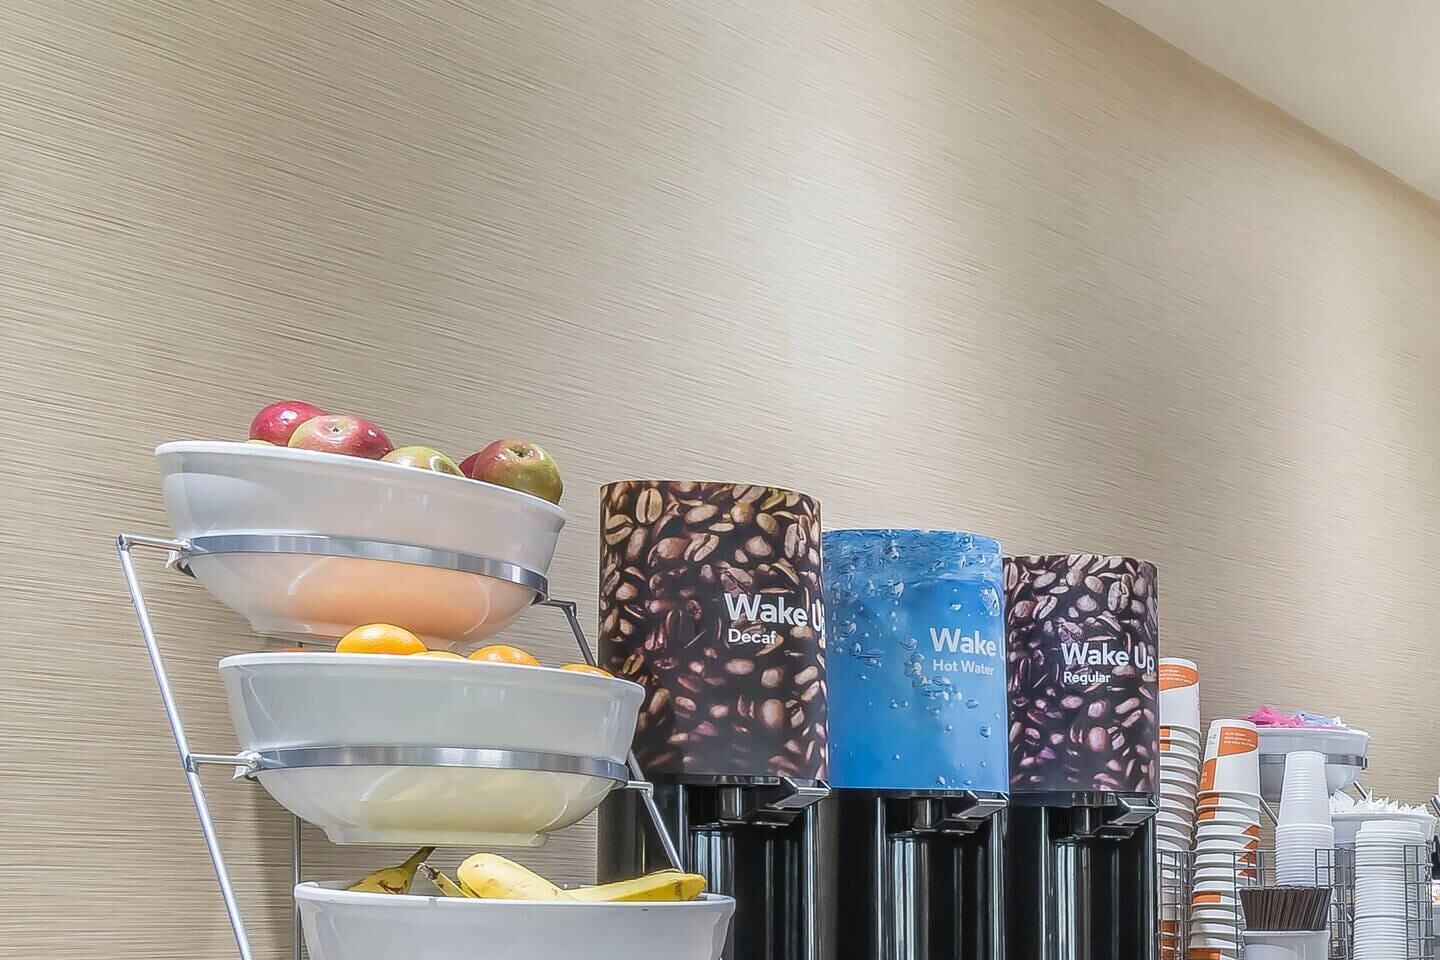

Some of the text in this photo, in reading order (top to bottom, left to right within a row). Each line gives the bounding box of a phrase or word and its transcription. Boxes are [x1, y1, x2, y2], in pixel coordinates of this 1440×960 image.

[724, 593, 808, 627] Wake
[728, 628, 777, 645] Decaf
[929, 627, 997, 657] Wake
[933, 659, 995, 676] Hot Water
[1060, 642, 1155, 676] Wake Up
[1063, 671, 1111, 686] Regular
